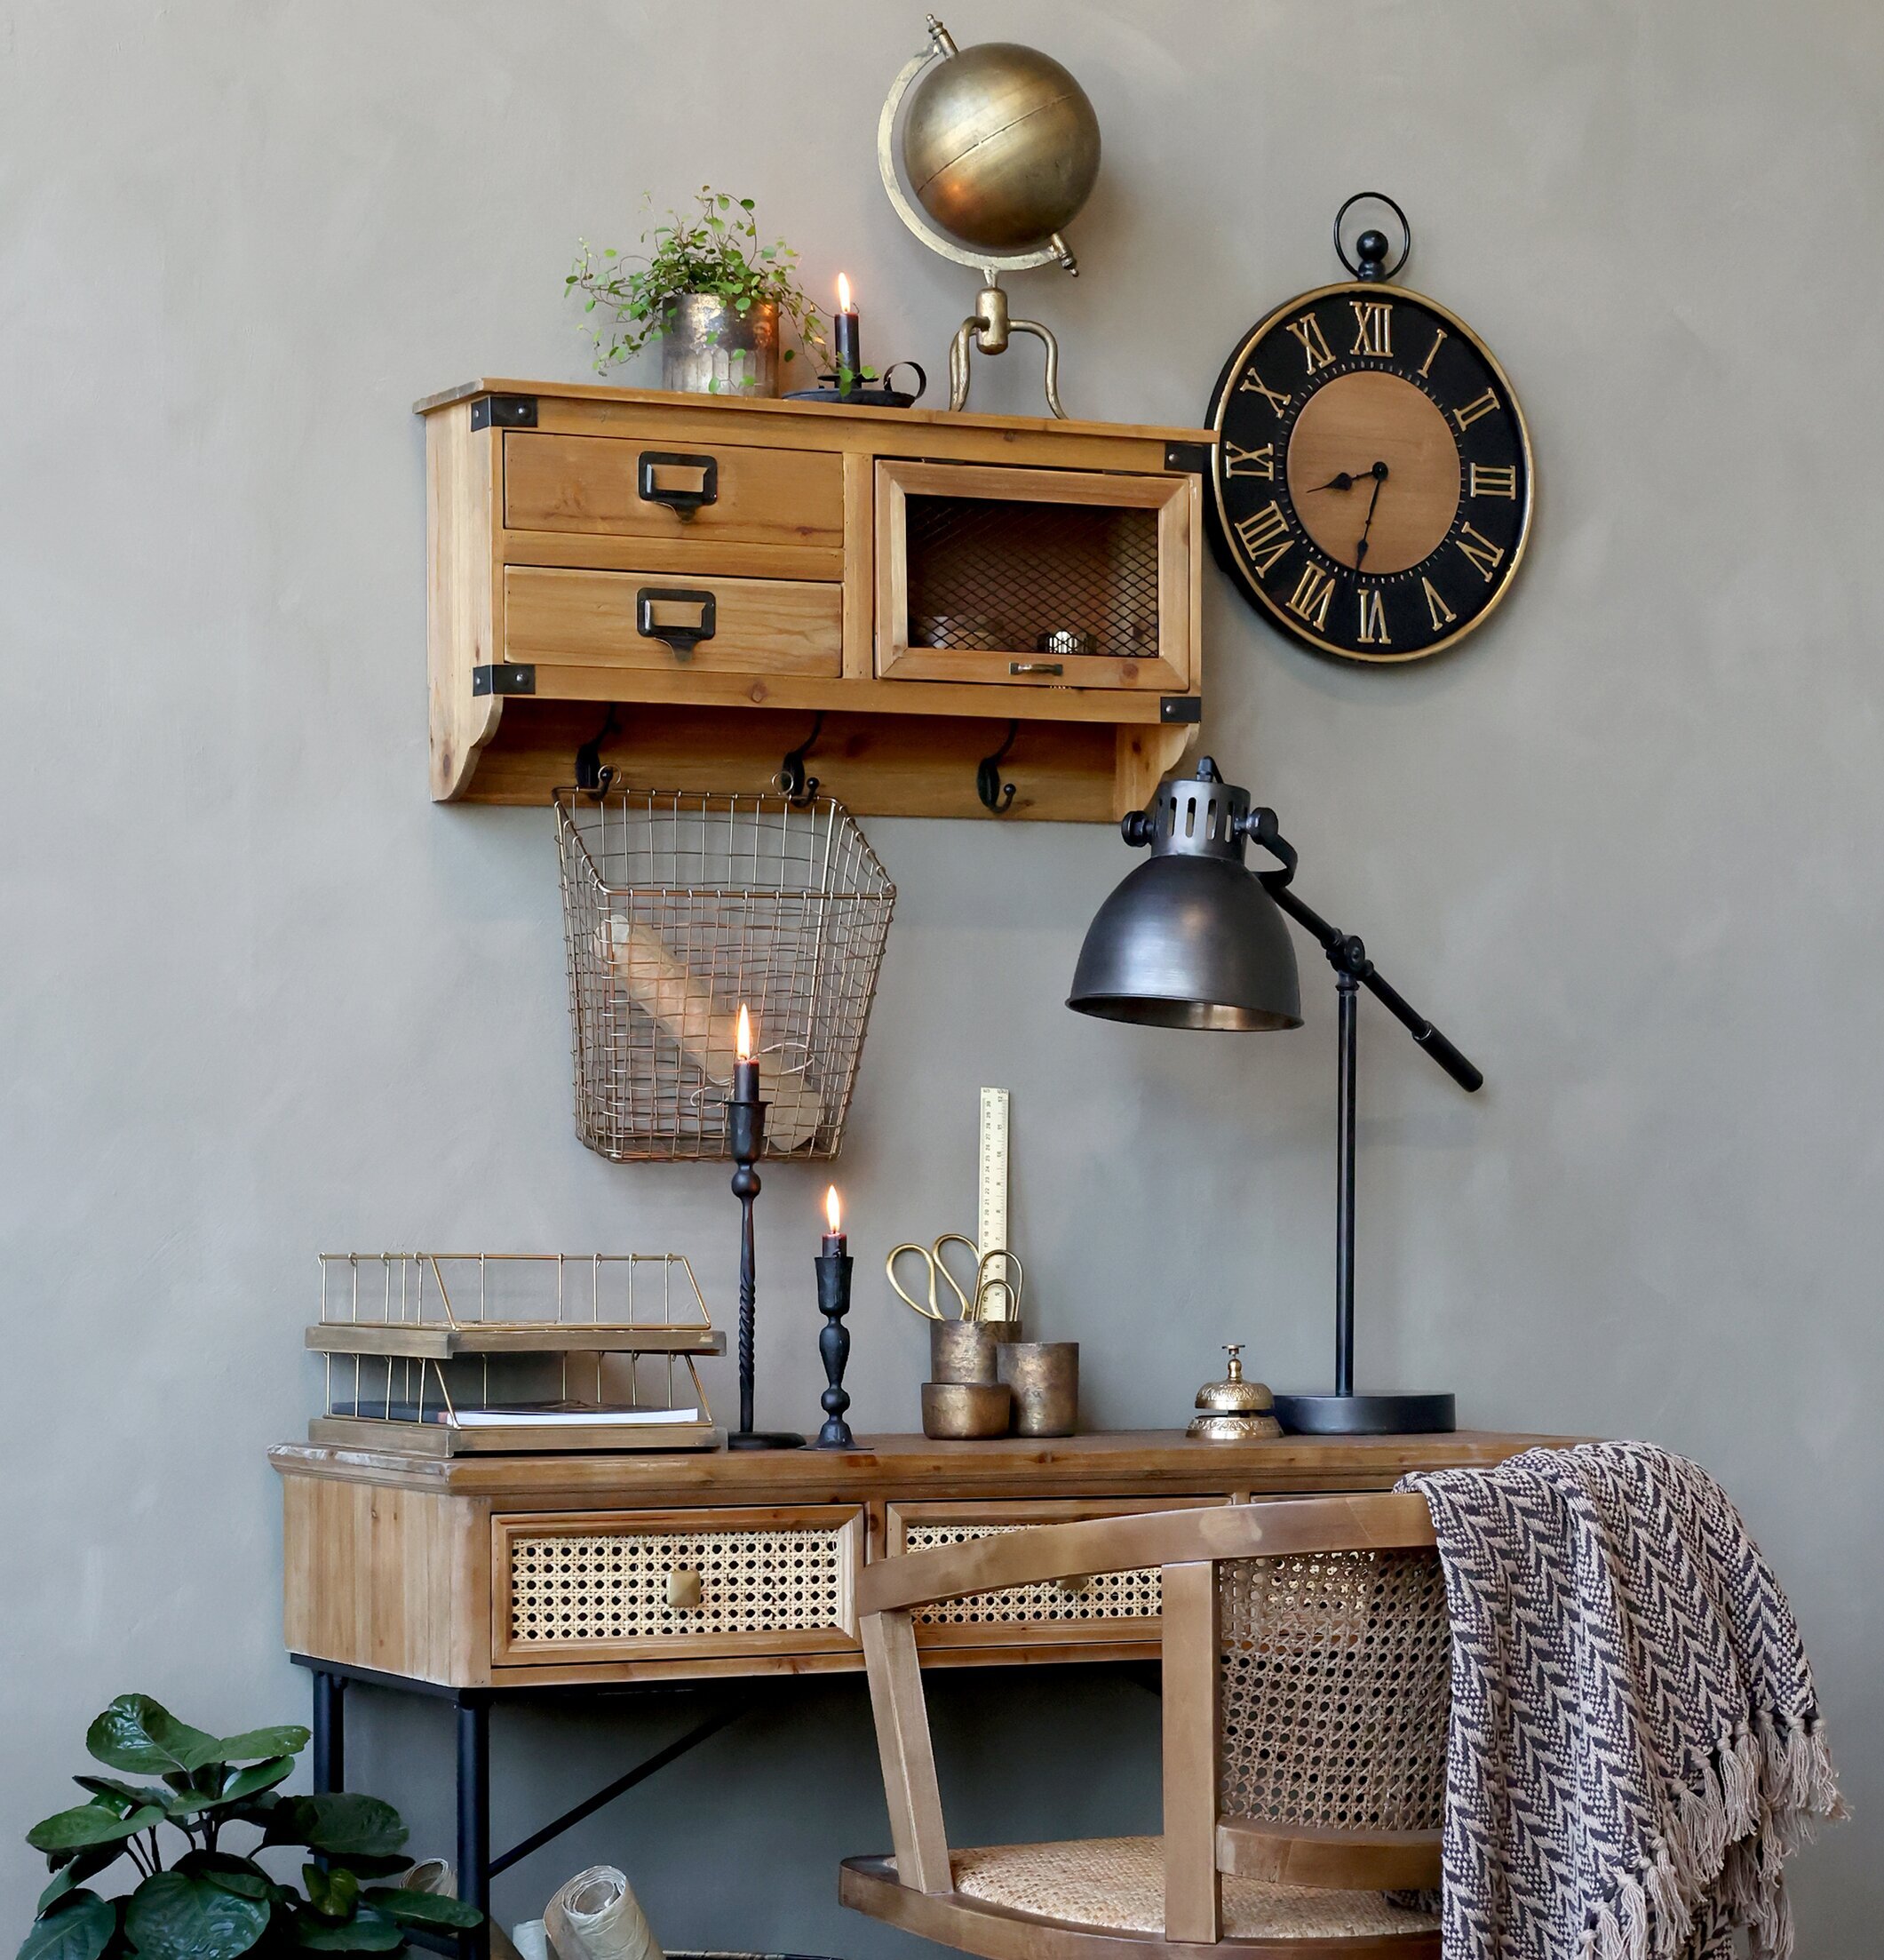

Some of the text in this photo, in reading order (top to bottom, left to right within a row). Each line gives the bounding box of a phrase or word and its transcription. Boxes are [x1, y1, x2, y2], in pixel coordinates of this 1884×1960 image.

[1285, 312, 1337, 376] XI
[1348, 300, 1395, 358] XII
[1417, 327, 1448, 379] I
[1239, 366, 1292, 419] X
[1452, 386, 1501, 433] II
[1224, 440, 1275, 482] IX
[1469, 461, 1516, 501] III
[1234, 499, 1296, 579] VIII
[1455, 521, 1506, 584] IV
[1284, 560, 1337, 633] VII
[1356, 588, 1392, 645] VI
[1421, 576, 1458, 632] V
